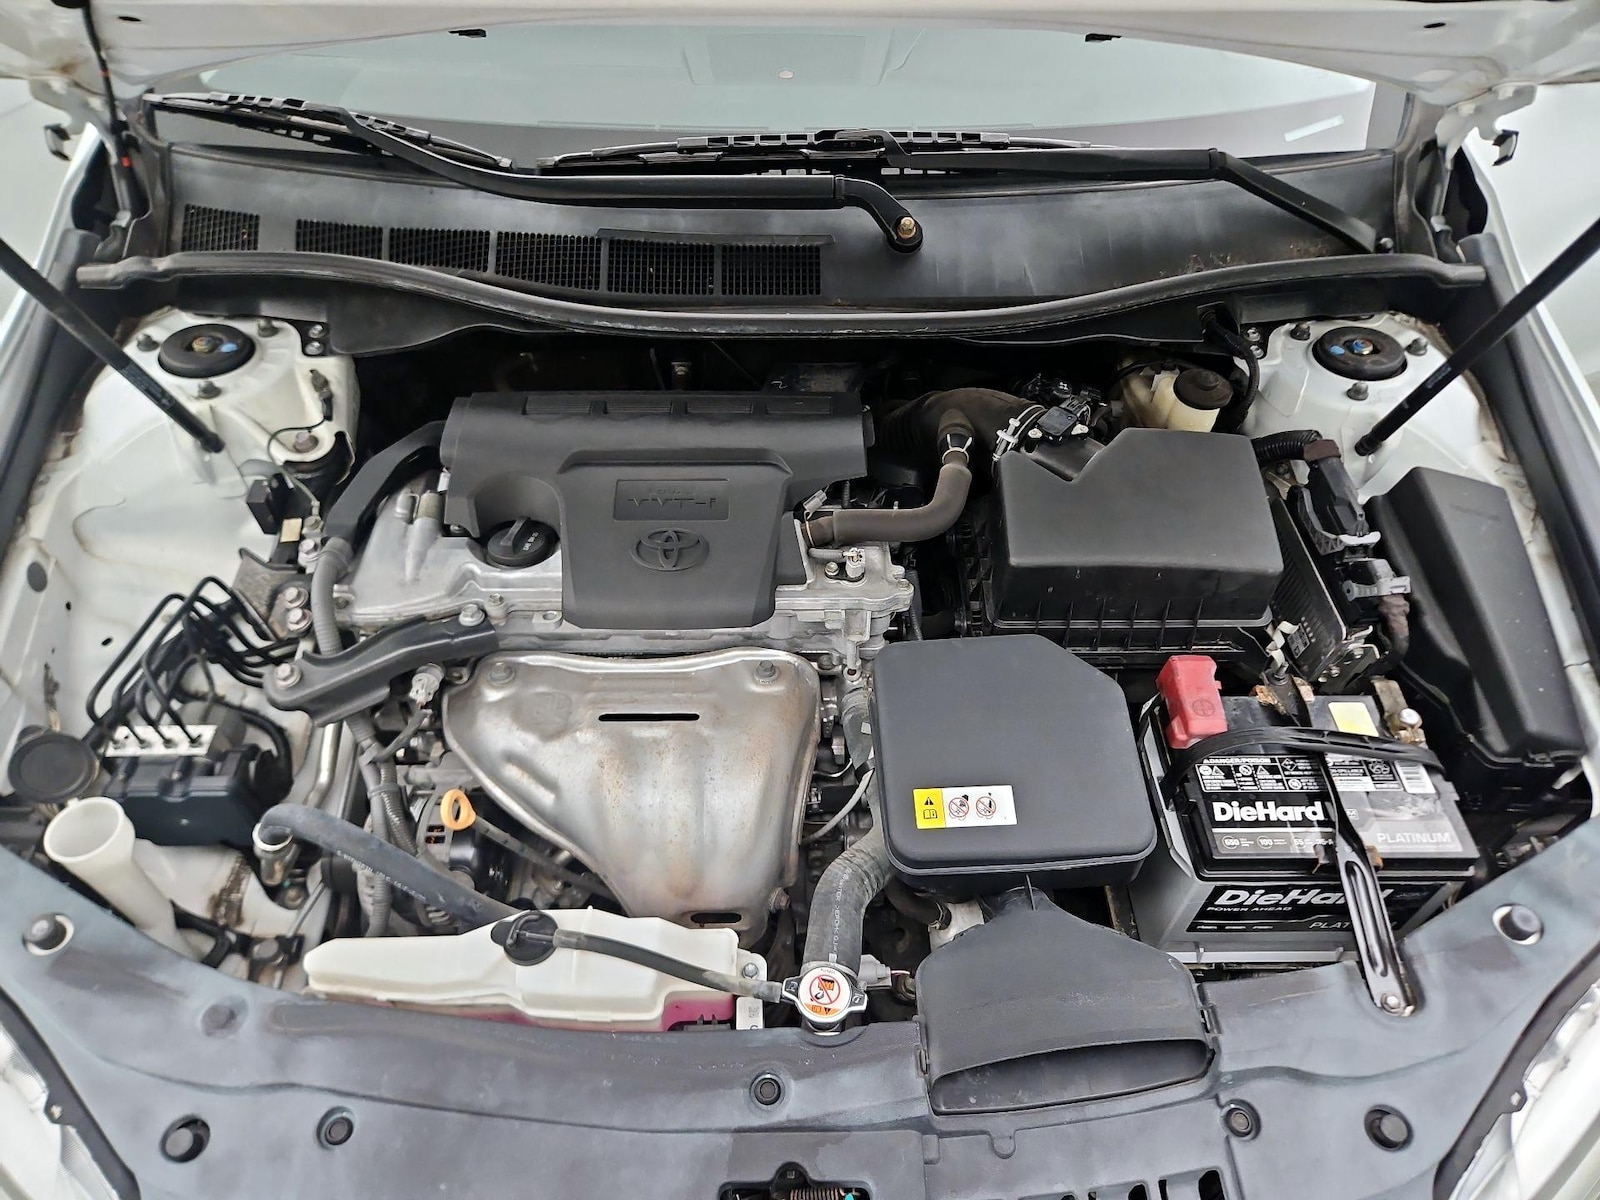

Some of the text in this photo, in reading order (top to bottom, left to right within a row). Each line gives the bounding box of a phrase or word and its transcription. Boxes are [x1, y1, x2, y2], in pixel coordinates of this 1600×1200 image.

[1212, 801, 1325, 821] DieHard
[1377, 832, 1451, 844] PLATINUM
[1213, 888, 1395, 906] DieHa
